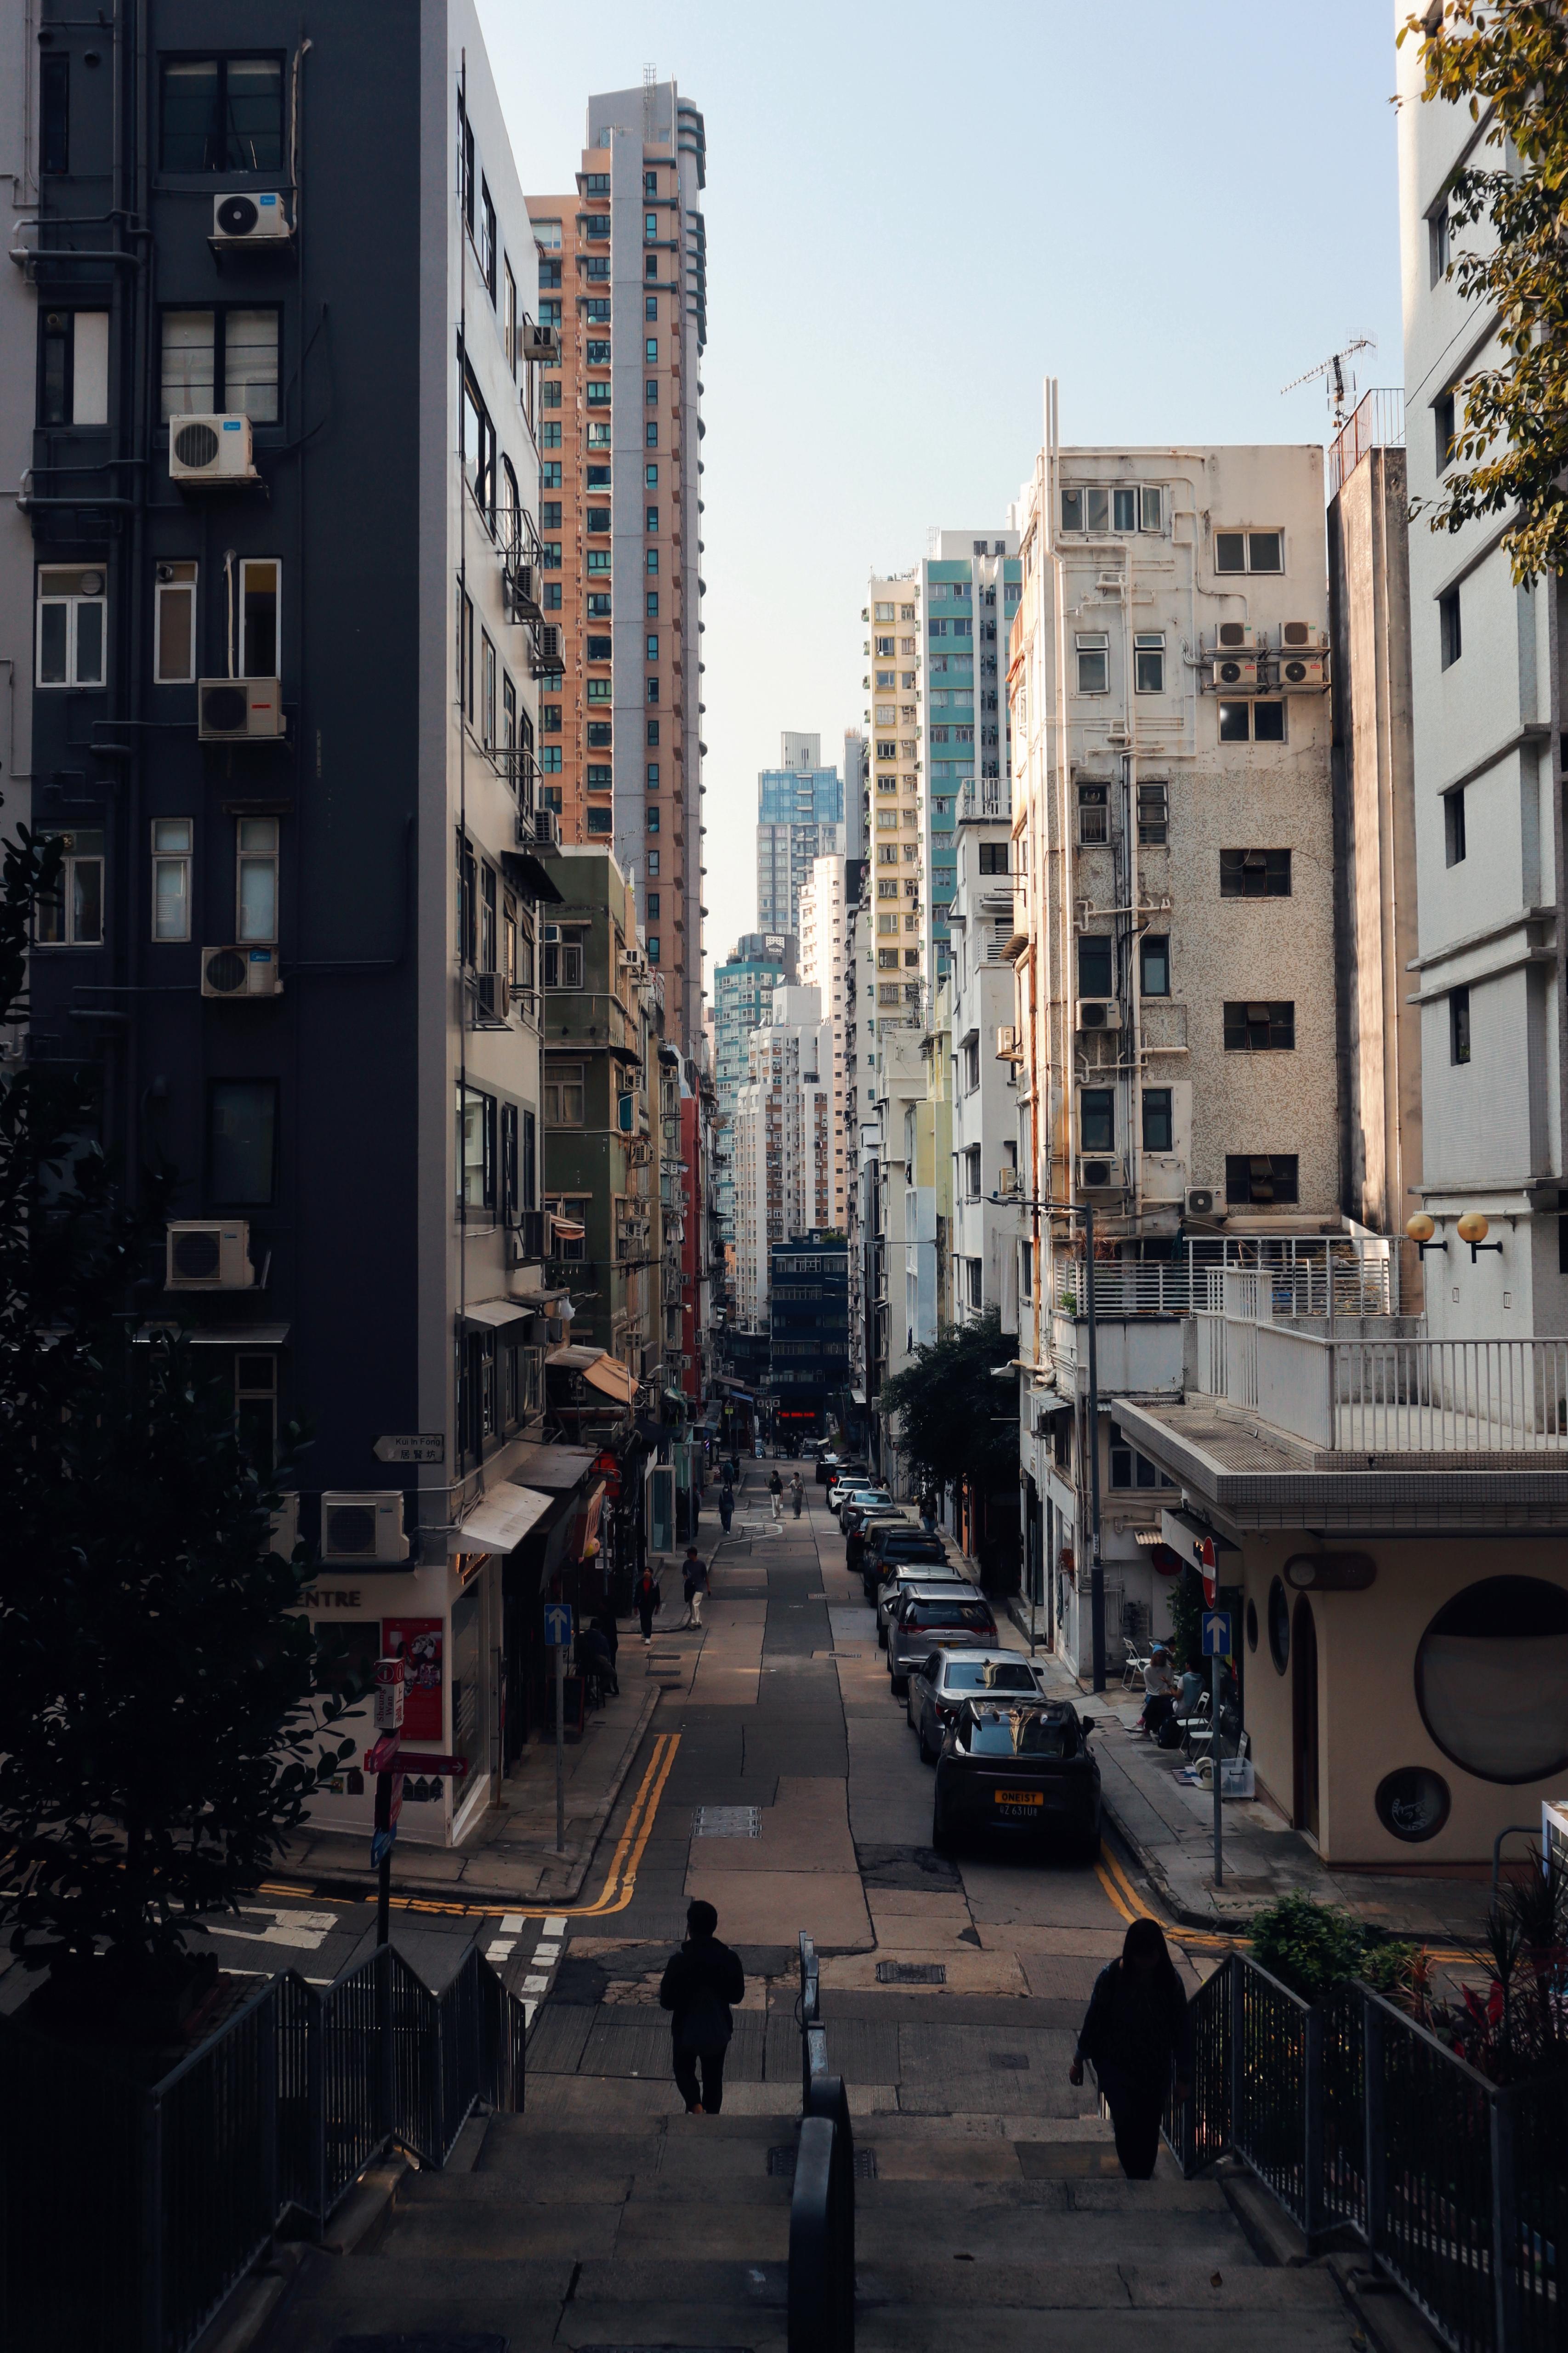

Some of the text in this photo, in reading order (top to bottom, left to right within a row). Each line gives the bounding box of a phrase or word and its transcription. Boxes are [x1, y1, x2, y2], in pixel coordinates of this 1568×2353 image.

[420, 1438, 440, 1446] Fong
[401, 1449, 436, 1459] 居賢坊
[293, 1591, 361, 1607] ENTRE
[377, 1689, 386, 1722] Sheung
[1002, 1793, 1037, 1802] ONEIST
